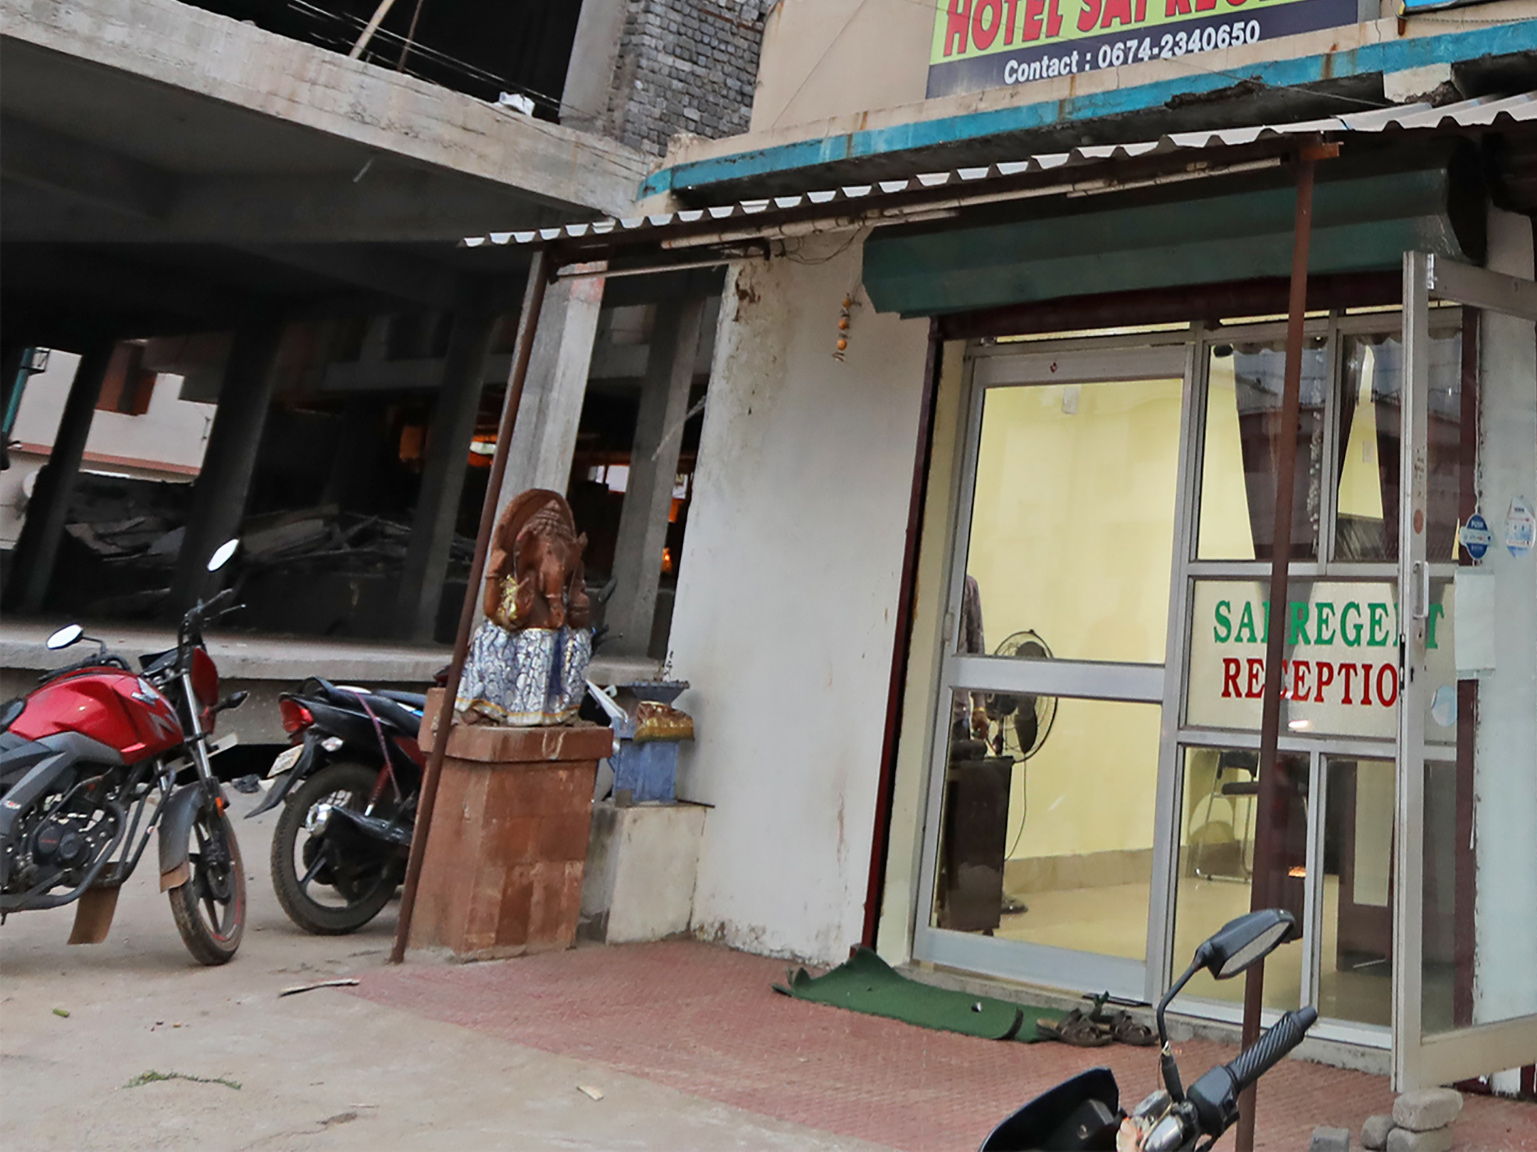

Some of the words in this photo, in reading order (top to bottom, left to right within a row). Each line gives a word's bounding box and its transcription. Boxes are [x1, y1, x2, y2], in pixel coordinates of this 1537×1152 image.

[1004, 55, 1079, 85] Contact
[1098, 19, 1261, 69] 0674-2340650
[1287, 600, 1445, 650] REGET
[1221, 657, 1398, 708] REEPTIO
